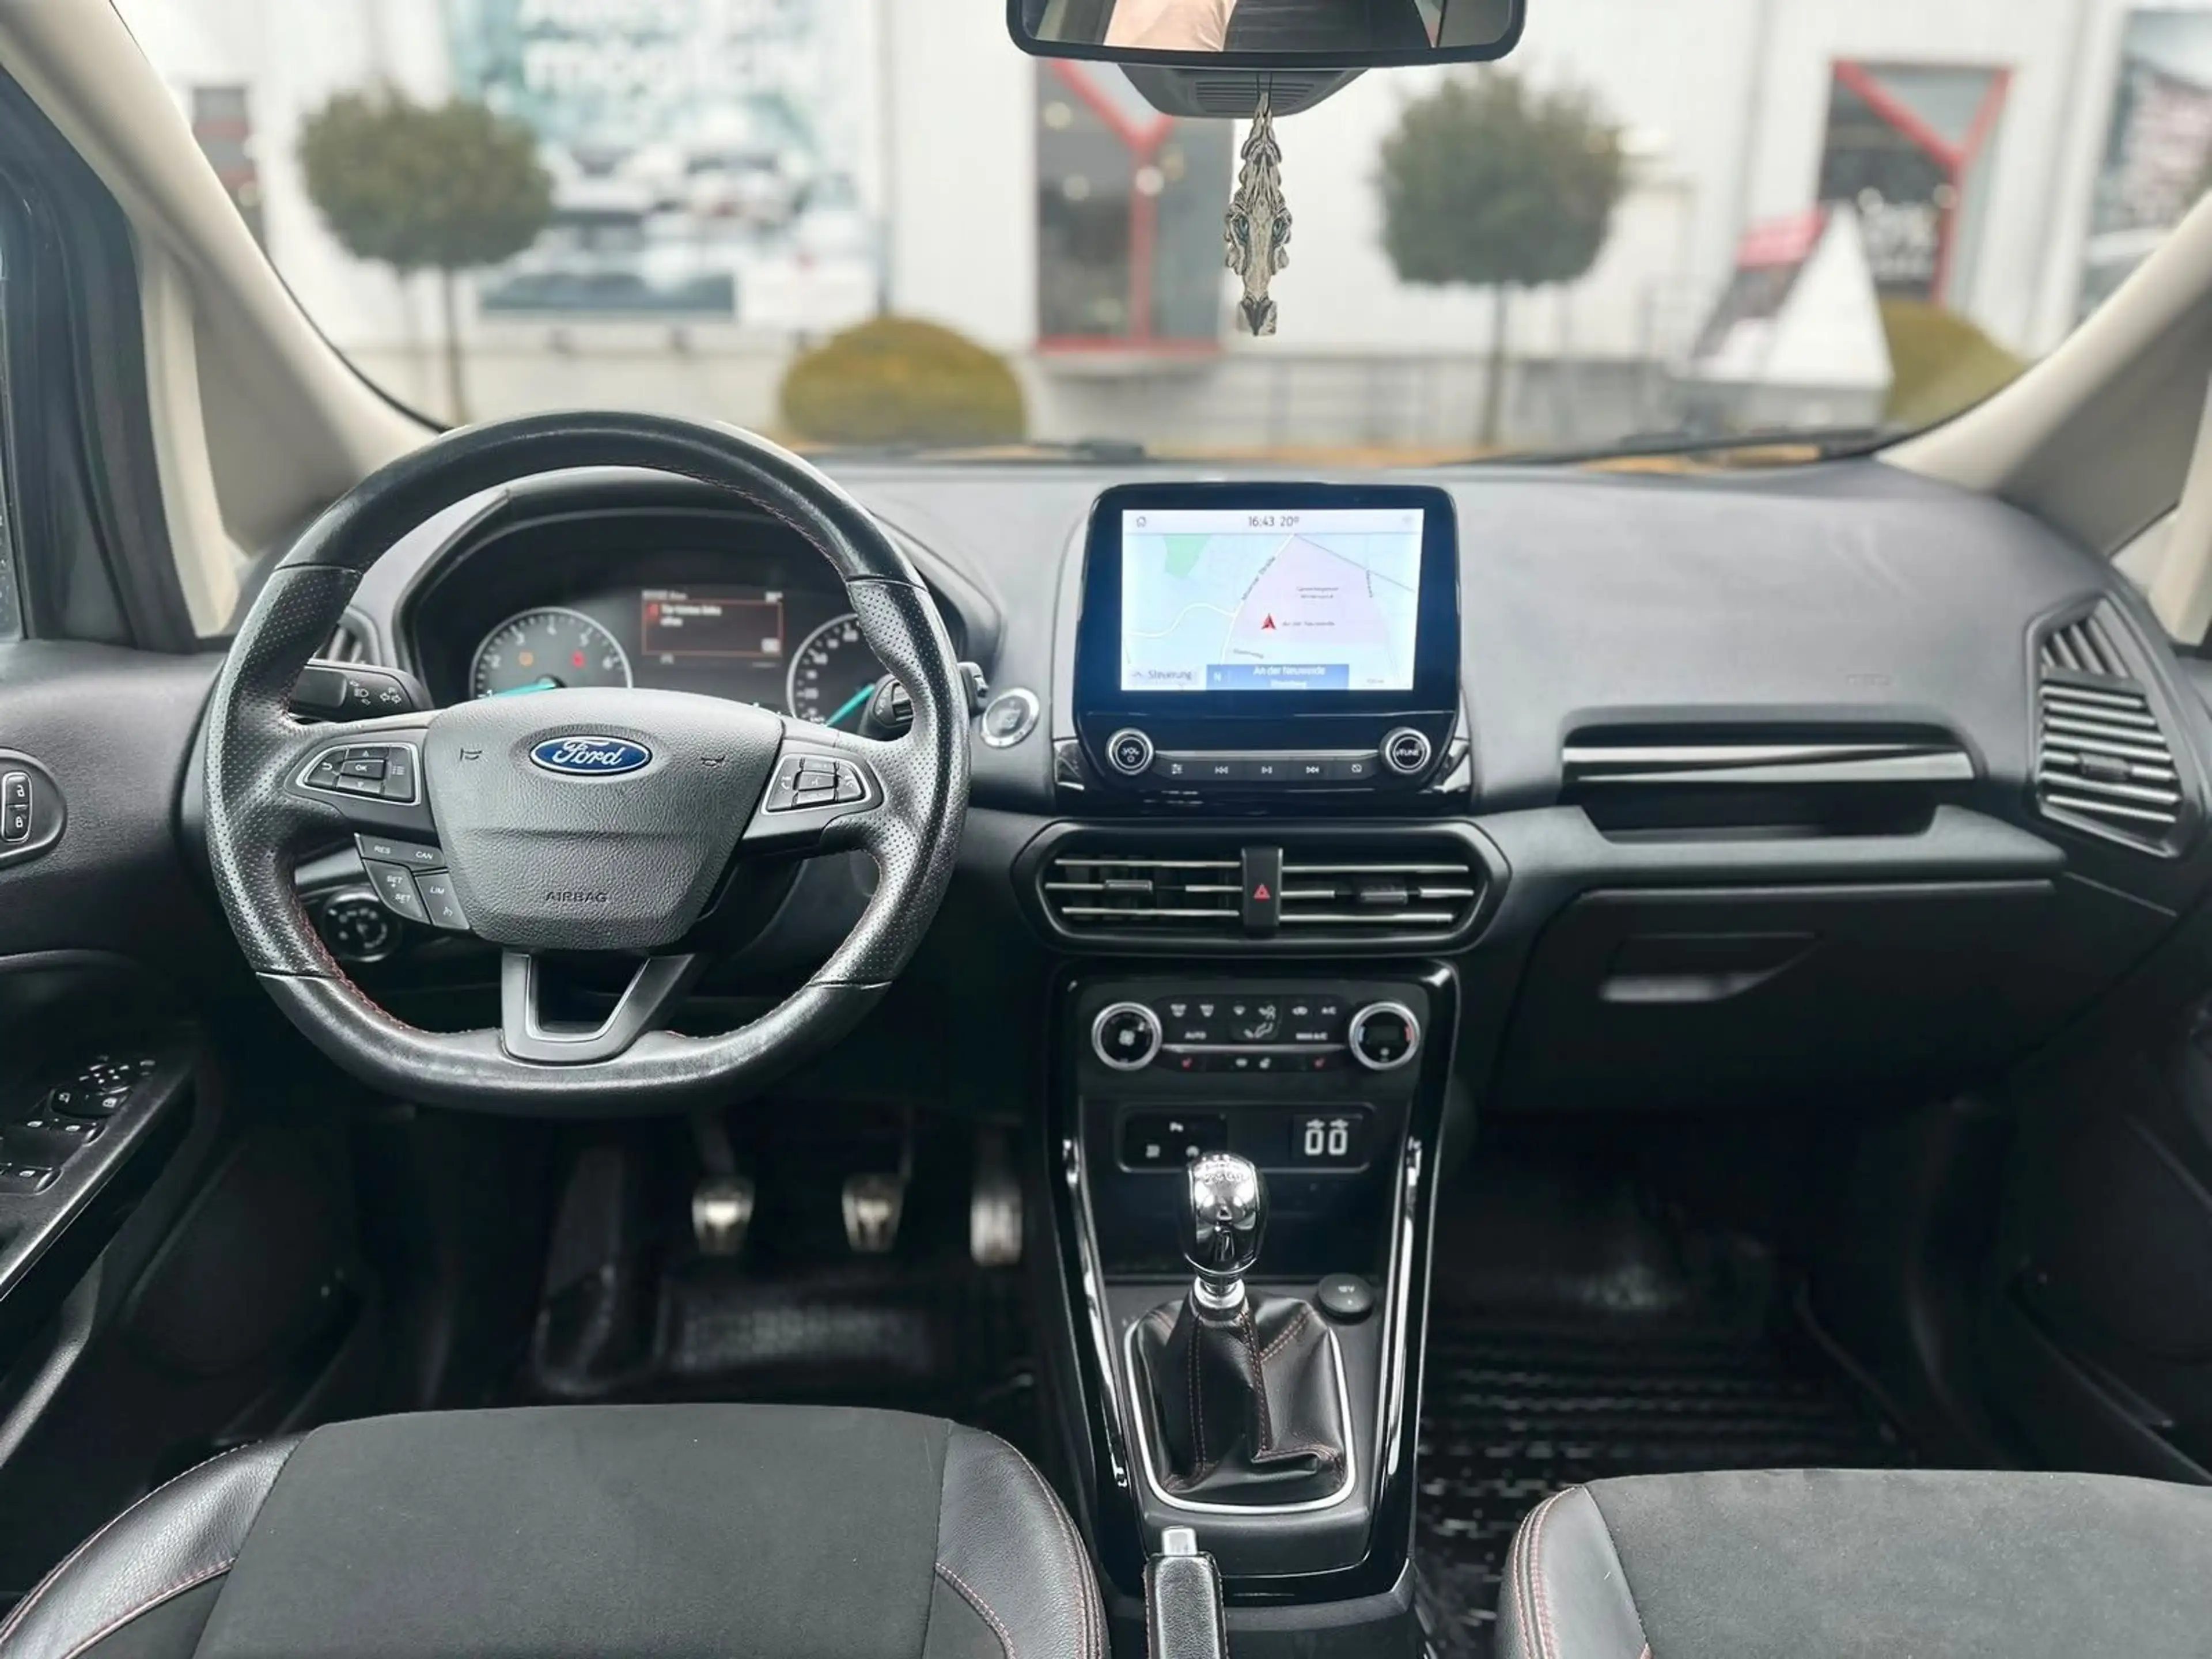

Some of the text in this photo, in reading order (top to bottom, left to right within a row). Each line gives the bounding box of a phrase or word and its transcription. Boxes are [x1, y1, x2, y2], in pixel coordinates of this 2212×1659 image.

[1248, 516, 1275, 527] 16:43
[1148, 670, 1192, 681] Steuerung
[551, 739, 626, 766] Ford
[355, 764, 368, 772] OK
[374, 845, 391, 855] RES
[416, 851, 433, 860] CAN
[387, 874, 403, 884] SET
[430, 886, 445, 894] LIM
[395, 893, 411, 903] SET
[546, 891, 609, 902] AIRBAG
[1184, 1030, 1207, 1040] AUTO
